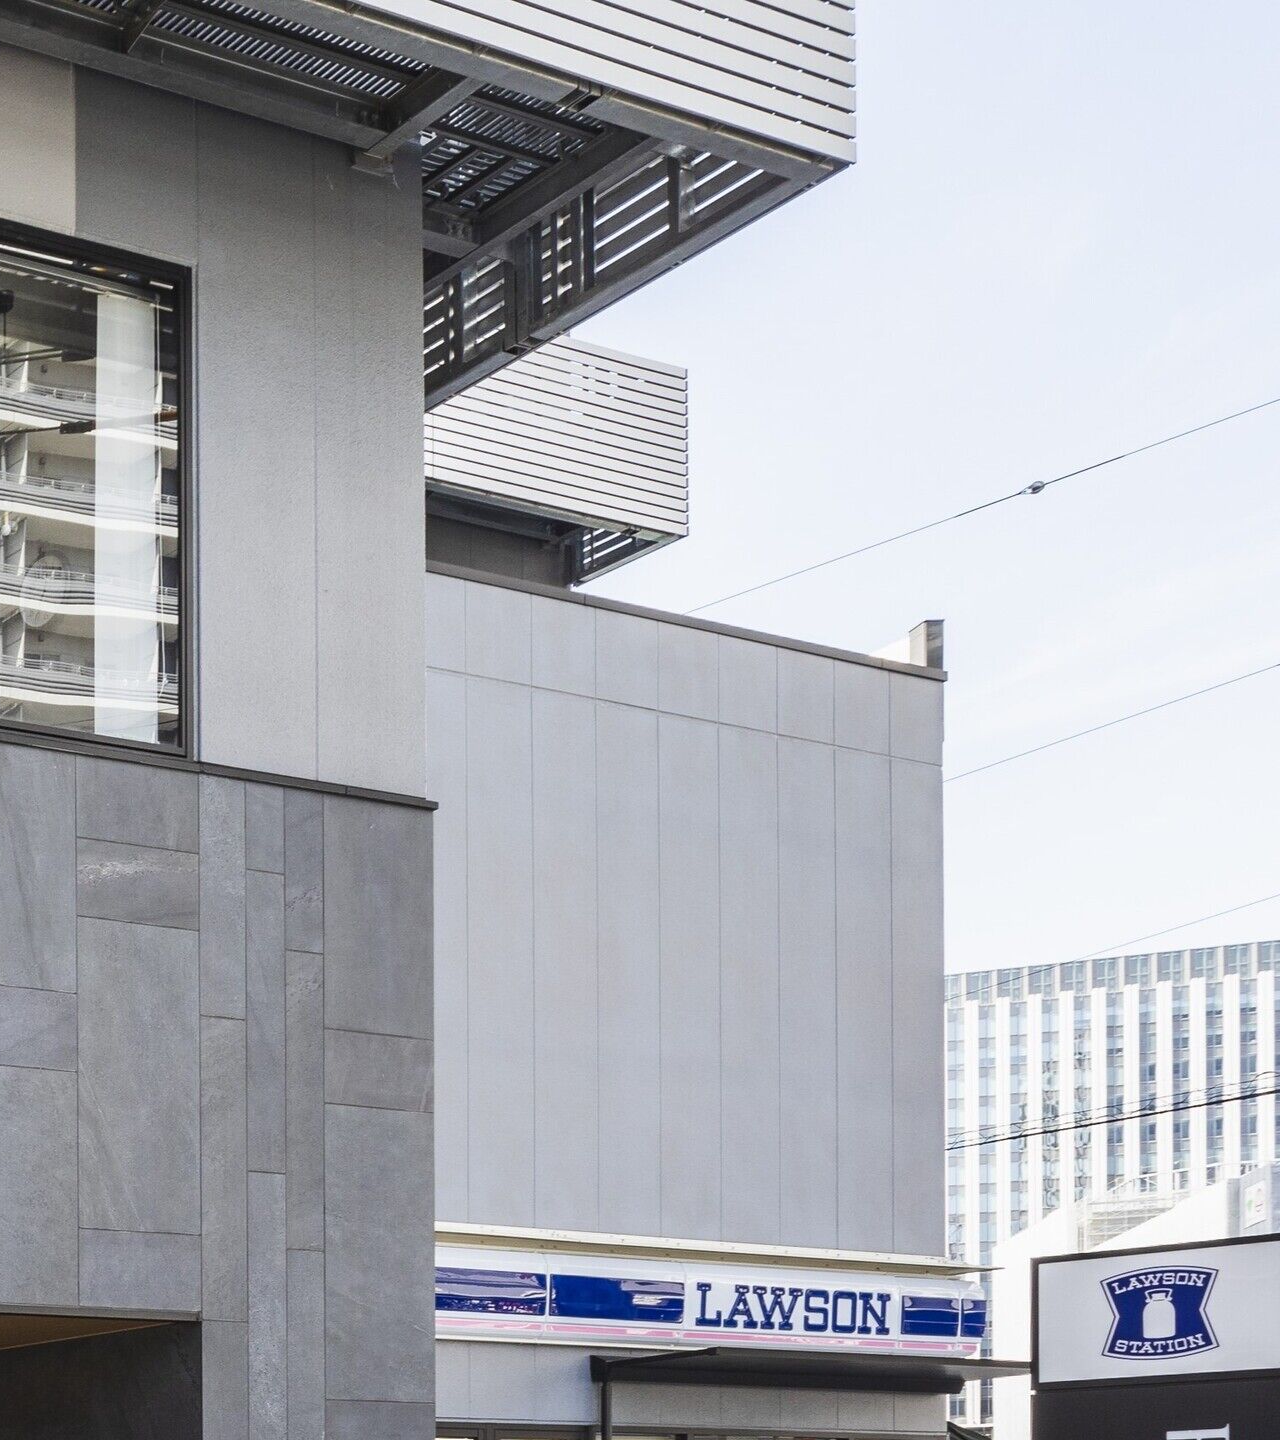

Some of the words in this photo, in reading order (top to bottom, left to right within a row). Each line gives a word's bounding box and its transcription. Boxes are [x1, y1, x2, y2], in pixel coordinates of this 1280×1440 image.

[1111, 1272, 1207, 1295] LAWSON
[696, 1282, 890, 1335] LAWSON
[1114, 1333, 1206, 1354] STATION
